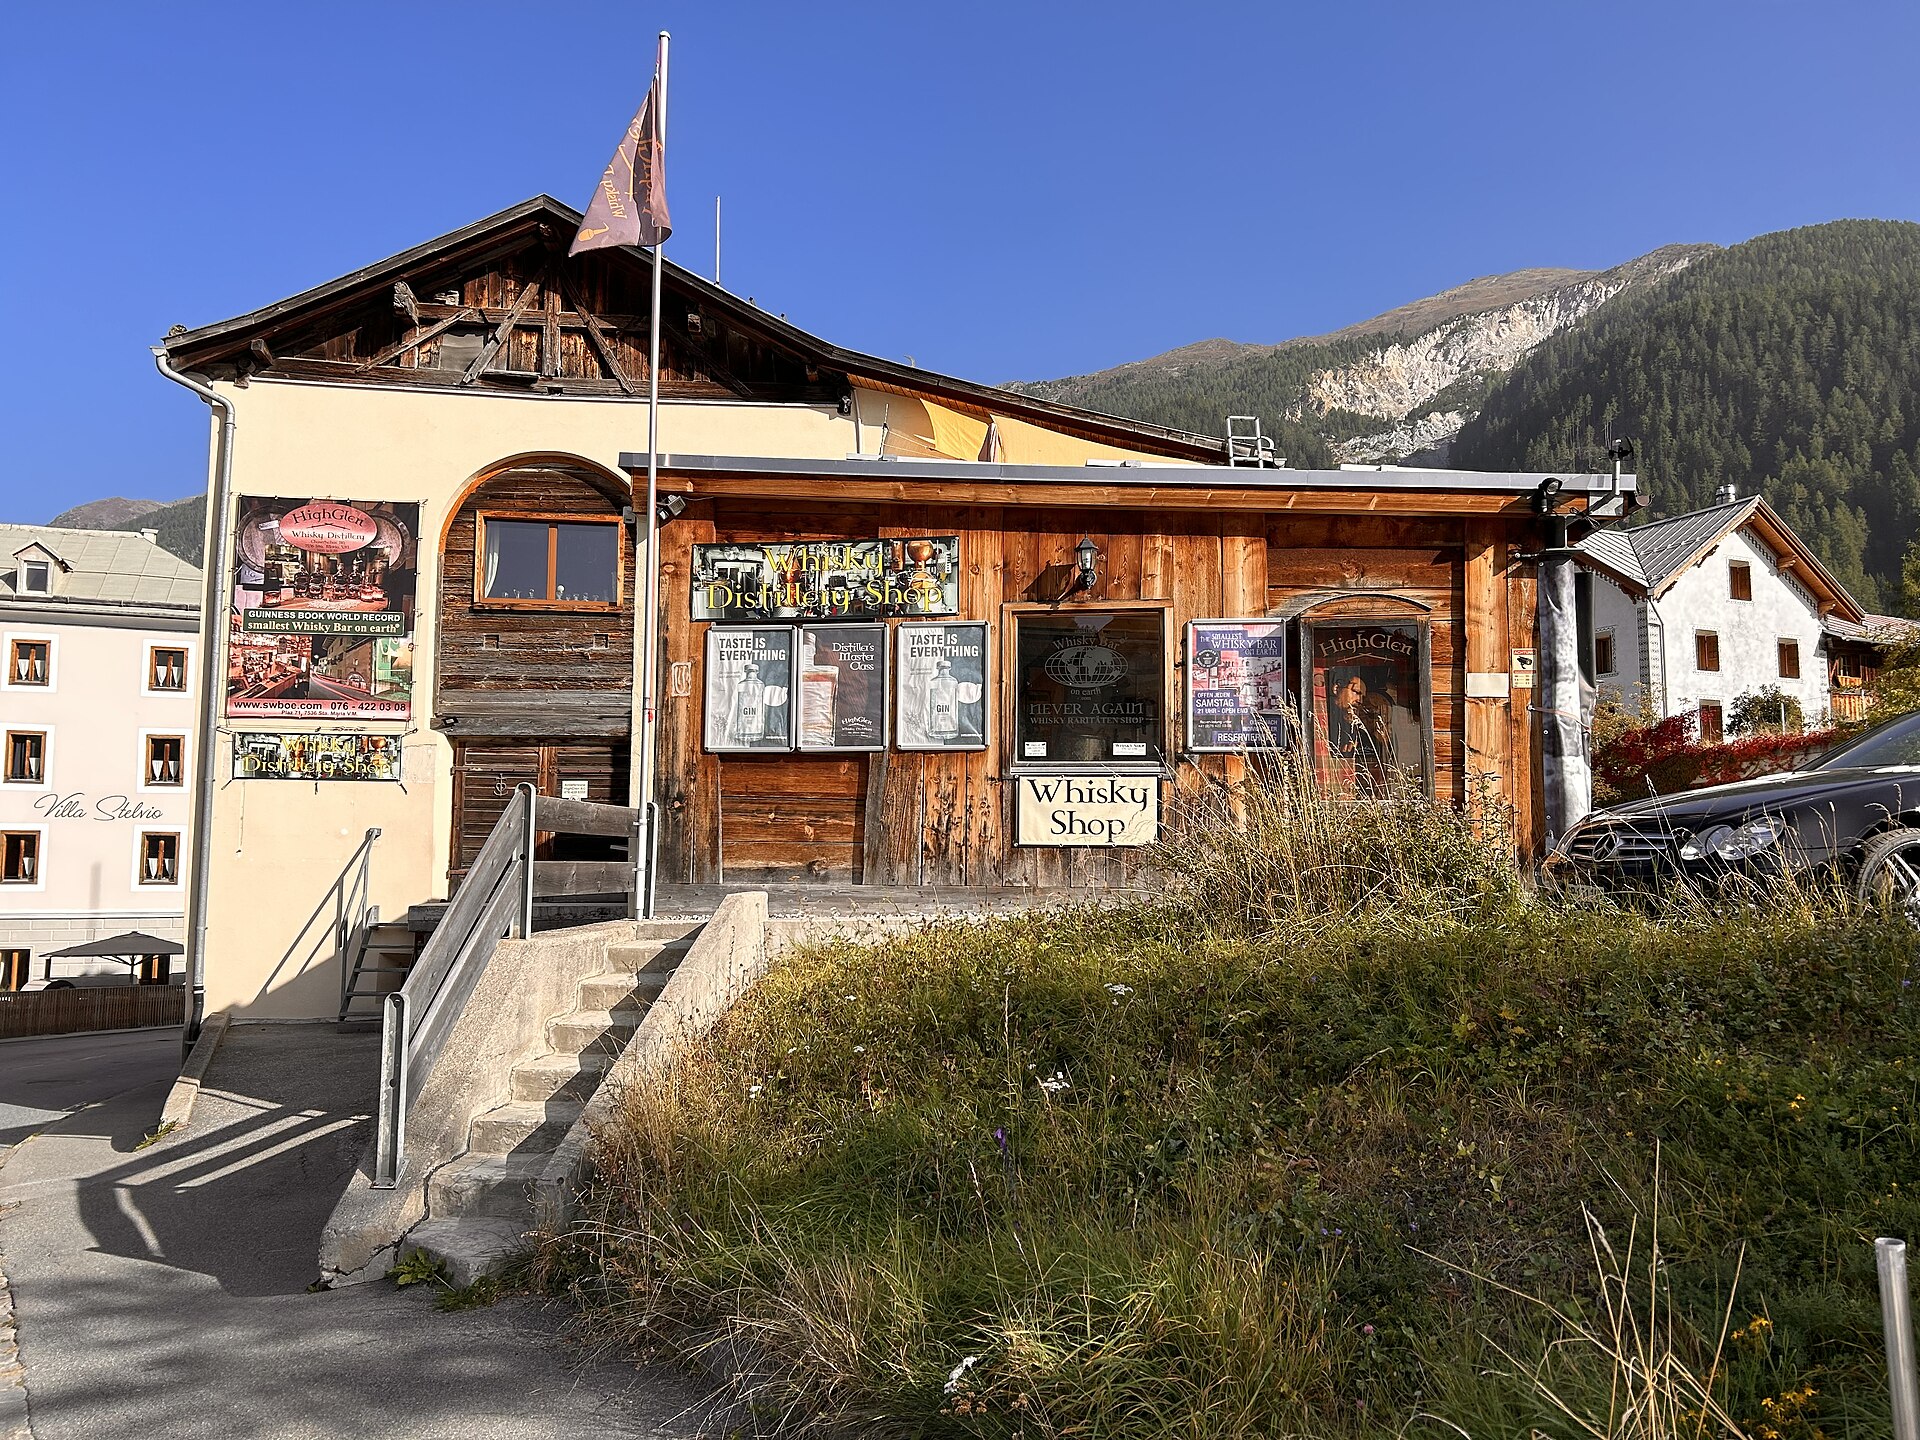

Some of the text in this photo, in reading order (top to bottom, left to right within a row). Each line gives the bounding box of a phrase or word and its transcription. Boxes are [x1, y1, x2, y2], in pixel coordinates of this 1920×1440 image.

[292, 508, 364, 527] HighGlen
[292, 530, 365, 541] Whisky Distillery
[764, 545, 883, 576] Whisky
[707, 579, 943, 614] Distillery Shop
[248, 611, 401, 622] GUINNESS BOOK WORLD RECORD
[247, 620, 290, 630] smallest
[291, 621, 331, 634] Whisky
[333, 623, 352, 632] Bar
[719, 638, 766, 649] TASTE IS
[910, 633, 958, 645] TASTE IS
[1052, 635, 1097, 650] Whisky
[1211, 639, 1277, 649] WHISKY BAR
[832, 642, 874, 653] Distiller's
[1319, 633, 1413, 658] HighGlen
[719, 650, 786, 661] EVERYTHING
[839, 652, 874, 662] Master
[910, 645, 979, 658] EVERYTHING
[849, 662, 874, 671] Class
[1082, 688, 1101, 696] earth
[330, 701, 349, 711] 076
[358, 702, 376, 711] 422
[379, 702, 391, 711] 03
[394, 703, 406, 712] 08
[936, 704, 950, 713] GIN
[1029, 702, 1144, 714] NEVER AGAIN
[1195, 699, 1234, 708] SAMSTAG
[743, 707, 757, 716] GIN
[1030, 715, 1144, 724] WHISKY RARITÄTEN SHOP
[280, 735, 357, 756] Whisky
[242, 756, 391, 778] Distillery Shop
[1027, 779, 1150, 812] Whisky
[33, 792, 163, 822] Villa Stelvio
[1050, 810, 1125, 843] Shop
